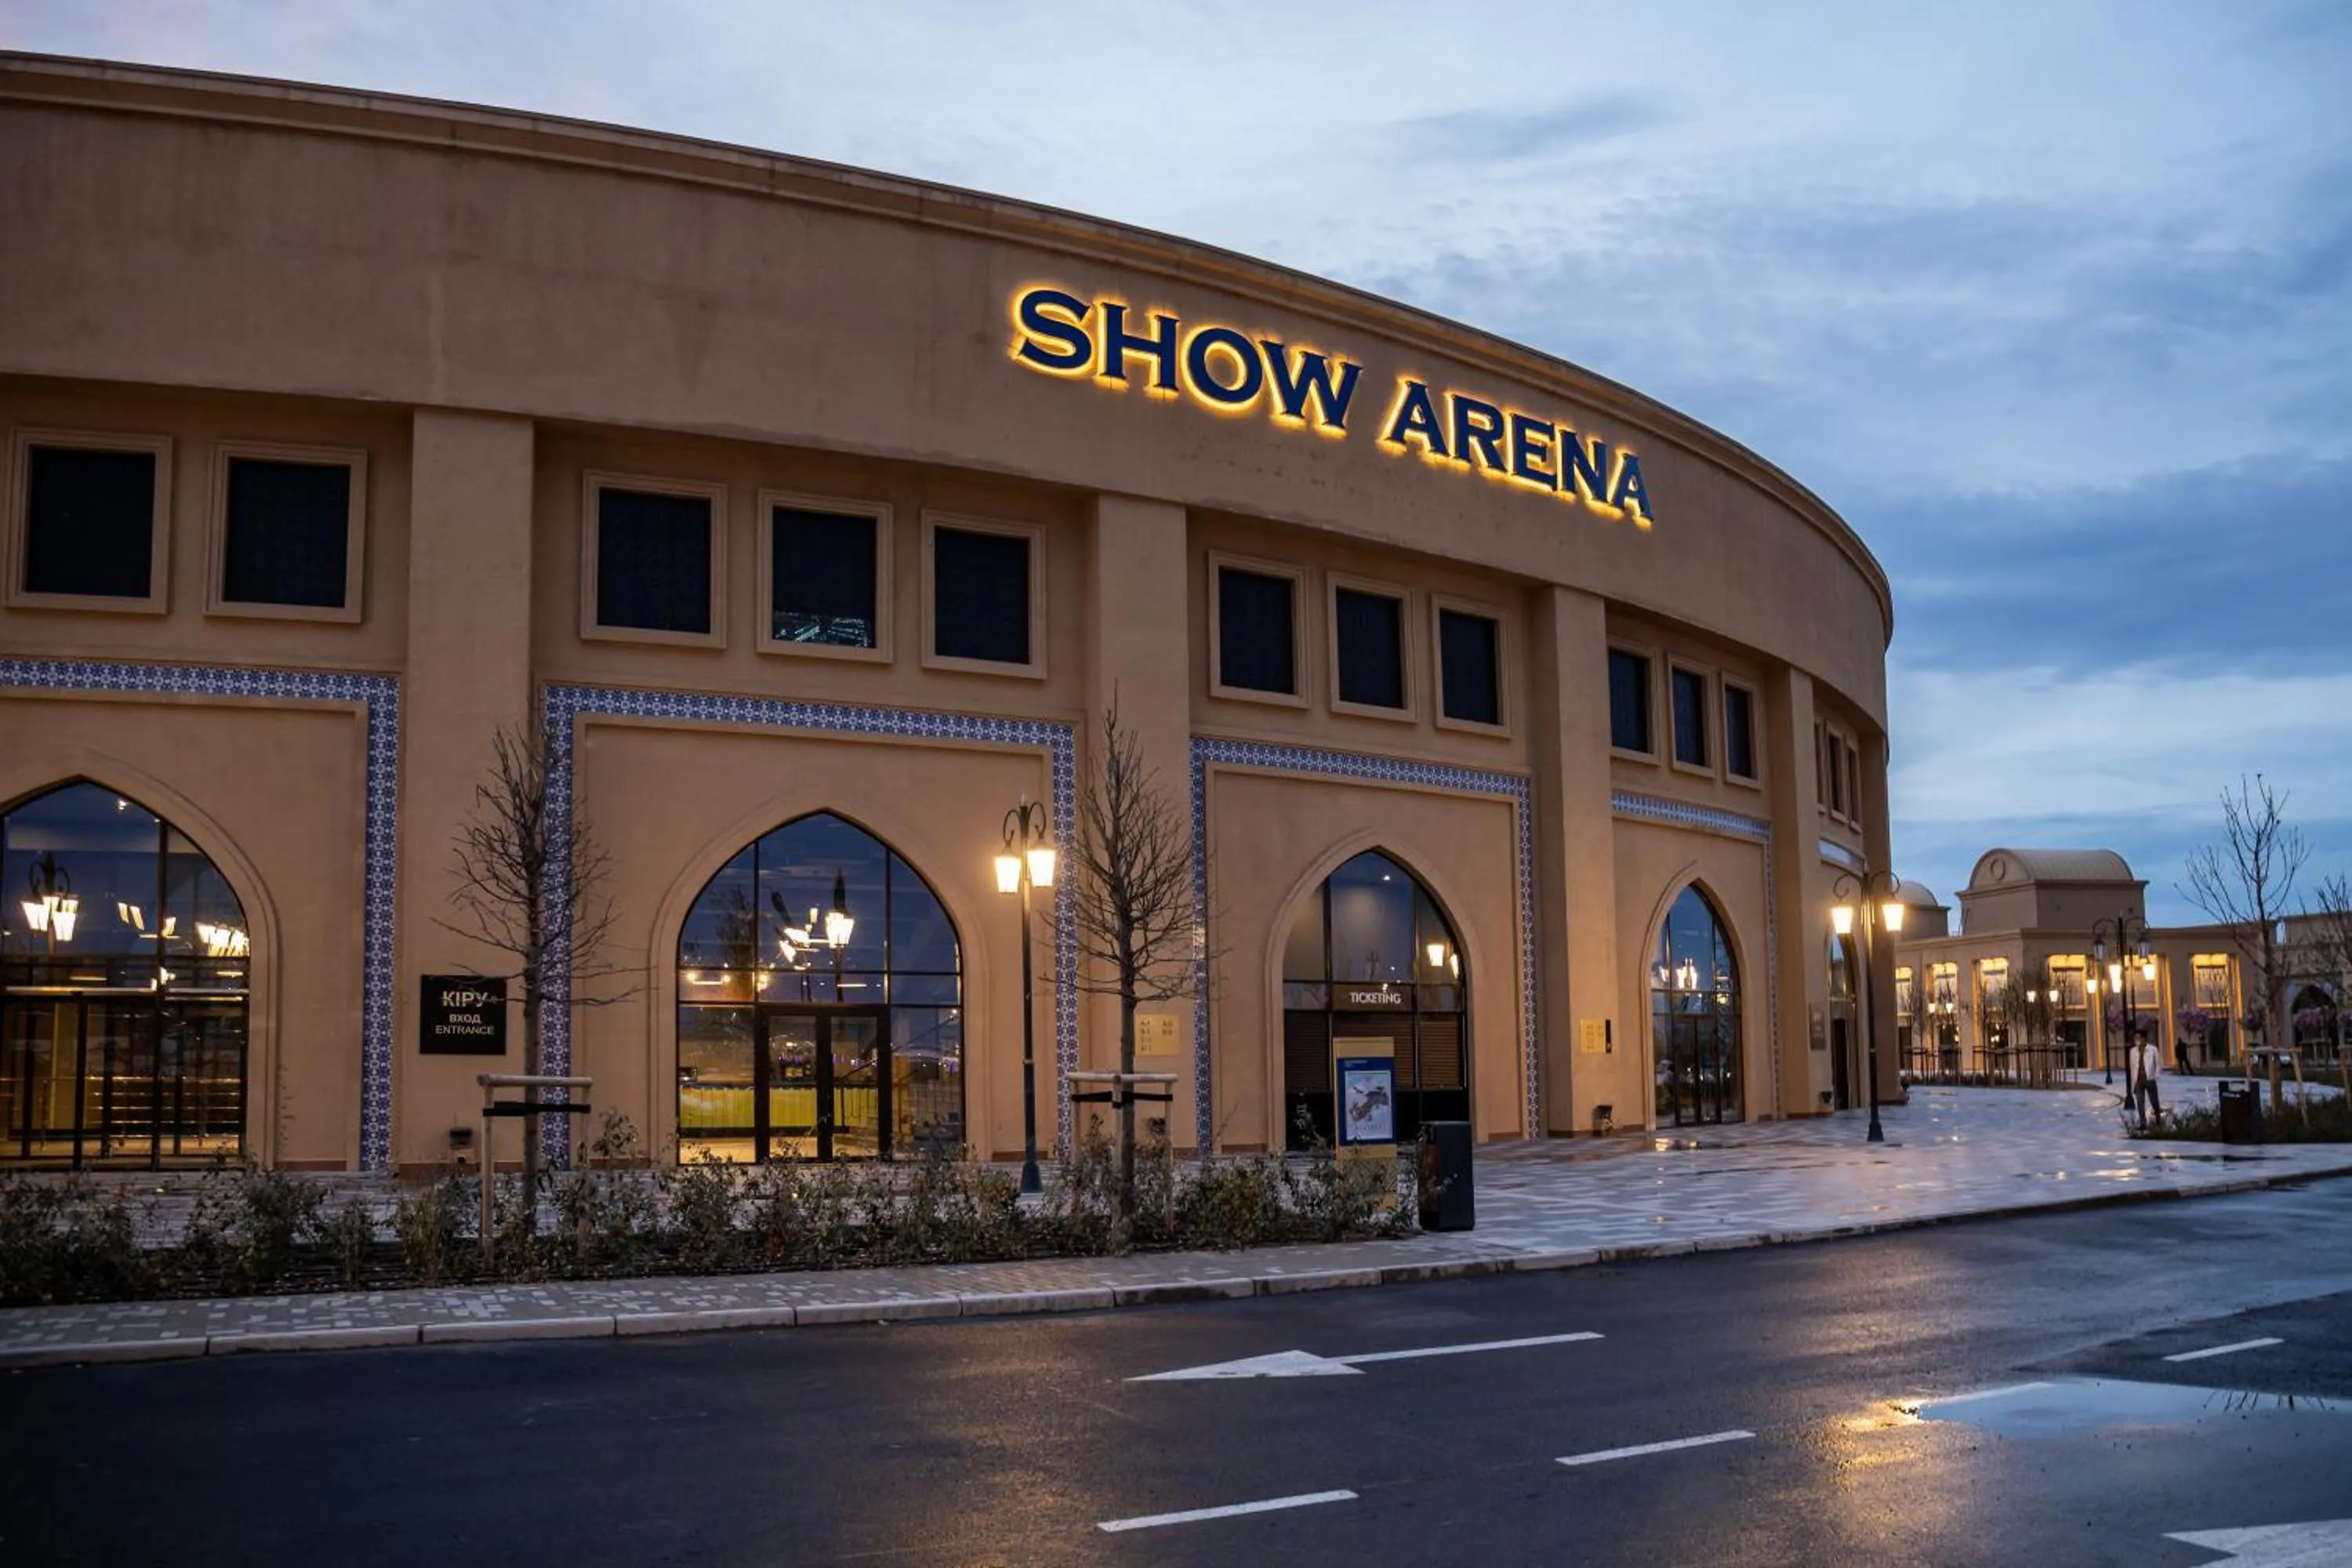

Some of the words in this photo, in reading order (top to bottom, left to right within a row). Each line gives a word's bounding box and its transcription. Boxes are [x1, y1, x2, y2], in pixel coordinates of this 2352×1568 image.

[1016, 289, 1363, 429] SHOW
[1385, 378, 1655, 523] ARENA
[1349, 991, 1402, 1004] TICKETING
[449, 1014, 481, 1024] ВХОД
[435, 1025, 495, 1035] ENTRANCE
